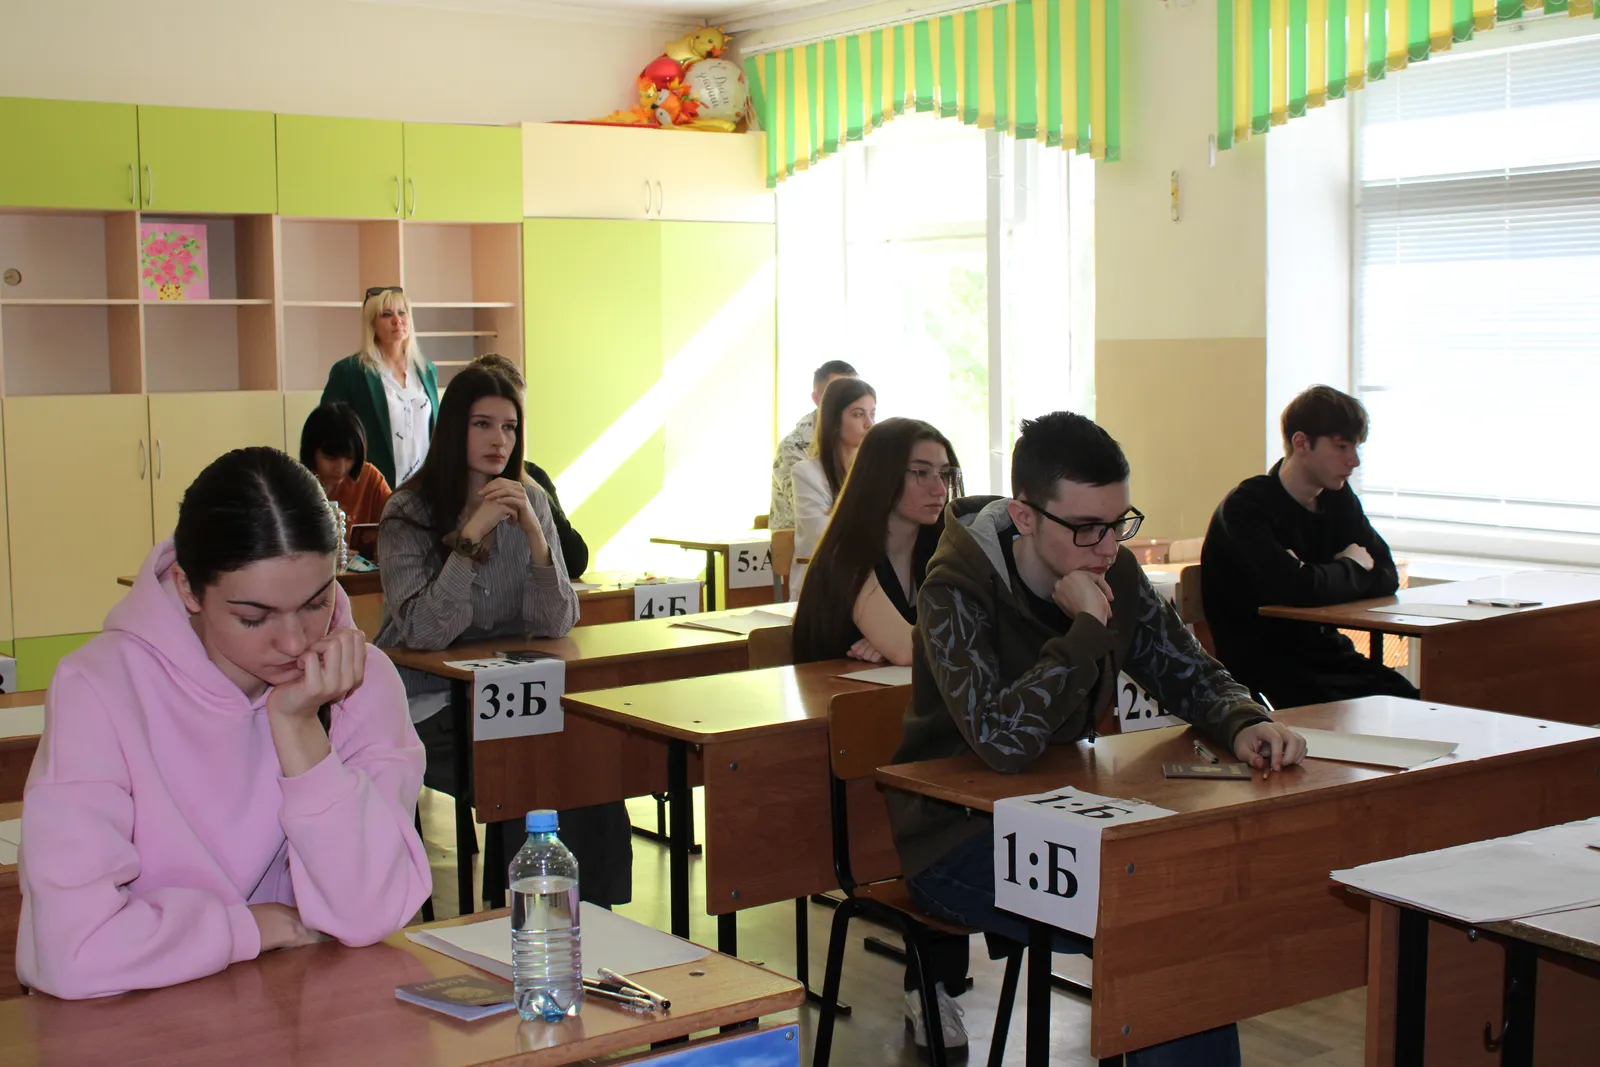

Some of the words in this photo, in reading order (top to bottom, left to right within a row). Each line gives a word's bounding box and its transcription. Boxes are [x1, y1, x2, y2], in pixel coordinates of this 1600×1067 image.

[479, 680, 548, 720] 3:Б
[1122, 682, 1171, 721] 2:
[1024, 794, 1134, 819] 1:Б
[1002, 831, 1079, 899] 1:Б
